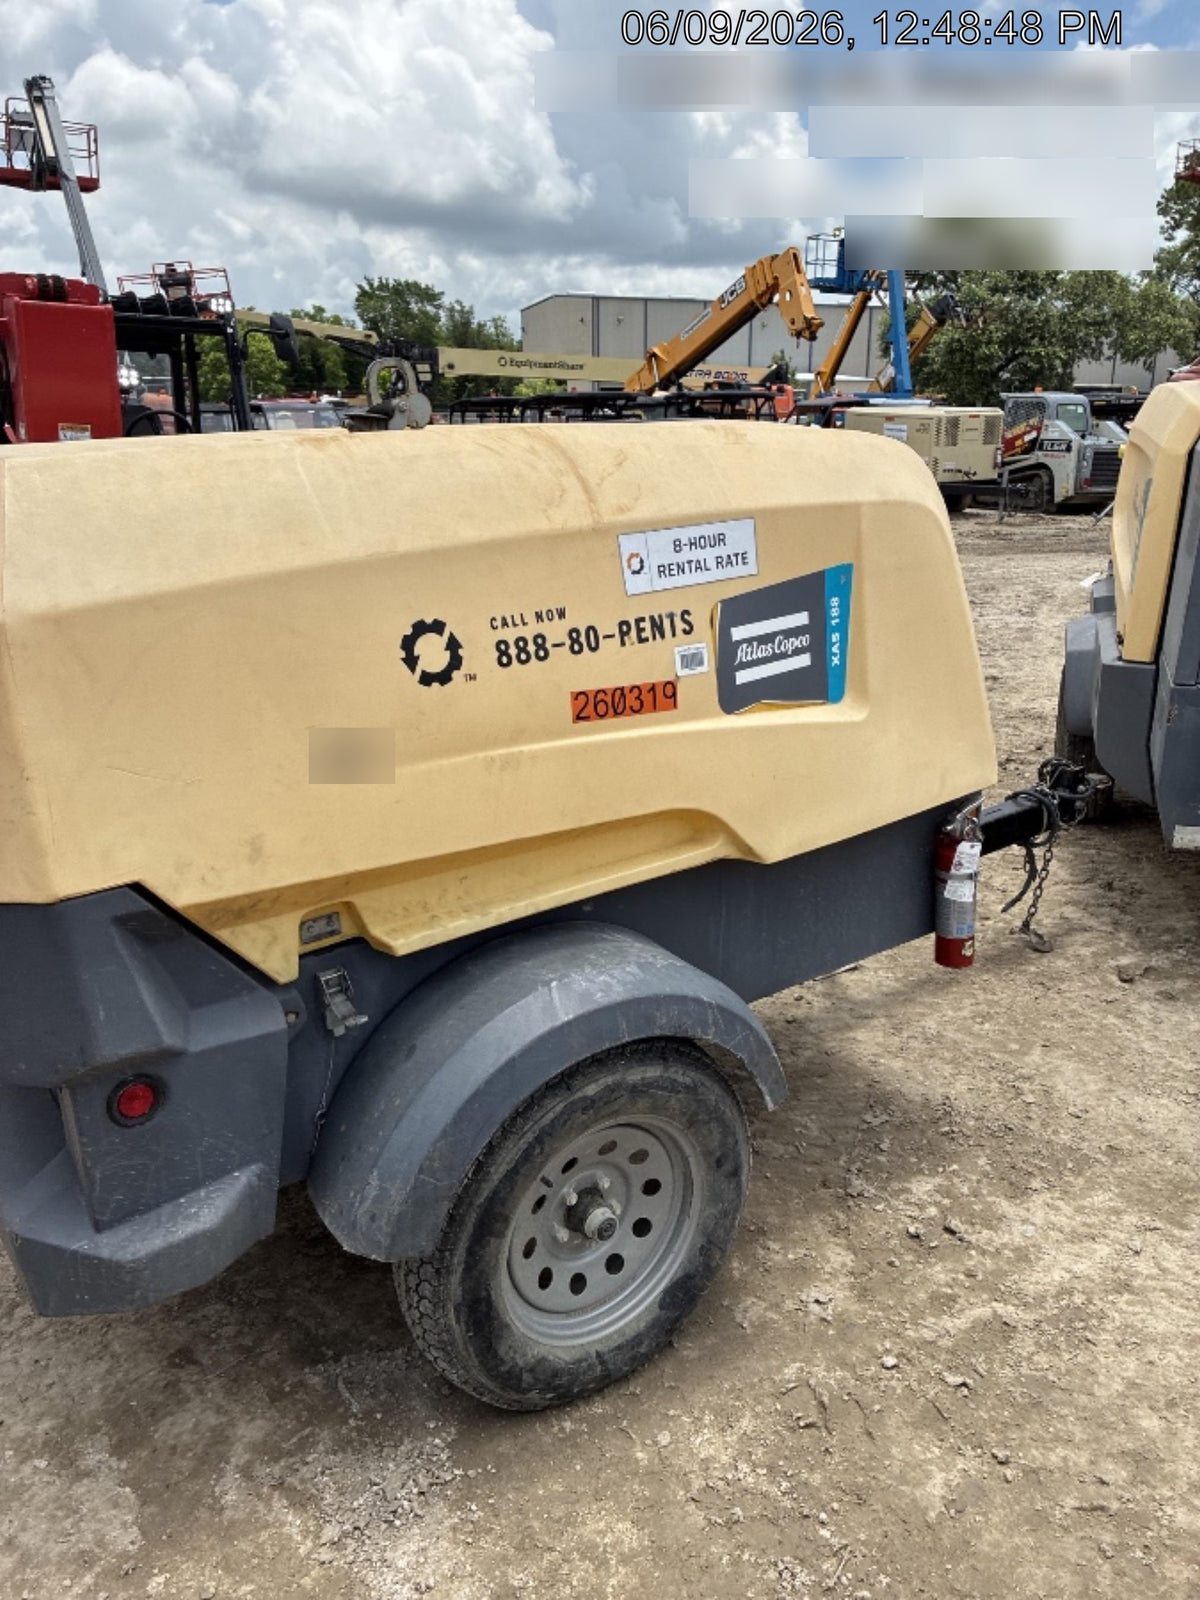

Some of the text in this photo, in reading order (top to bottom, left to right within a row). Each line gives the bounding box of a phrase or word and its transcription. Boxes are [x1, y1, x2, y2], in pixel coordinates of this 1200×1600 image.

[721, 277, 746, 309] JCB
[685, 369, 712, 380] TRA
[673, 533, 727, 553] 8-HOUR
[658, 551, 749, 579] RENTAL RATE
[490, 606, 567, 630] CALL NOW
[830, 596, 840, 667] XAS 188
[573, 680, 677, 722] 260319
